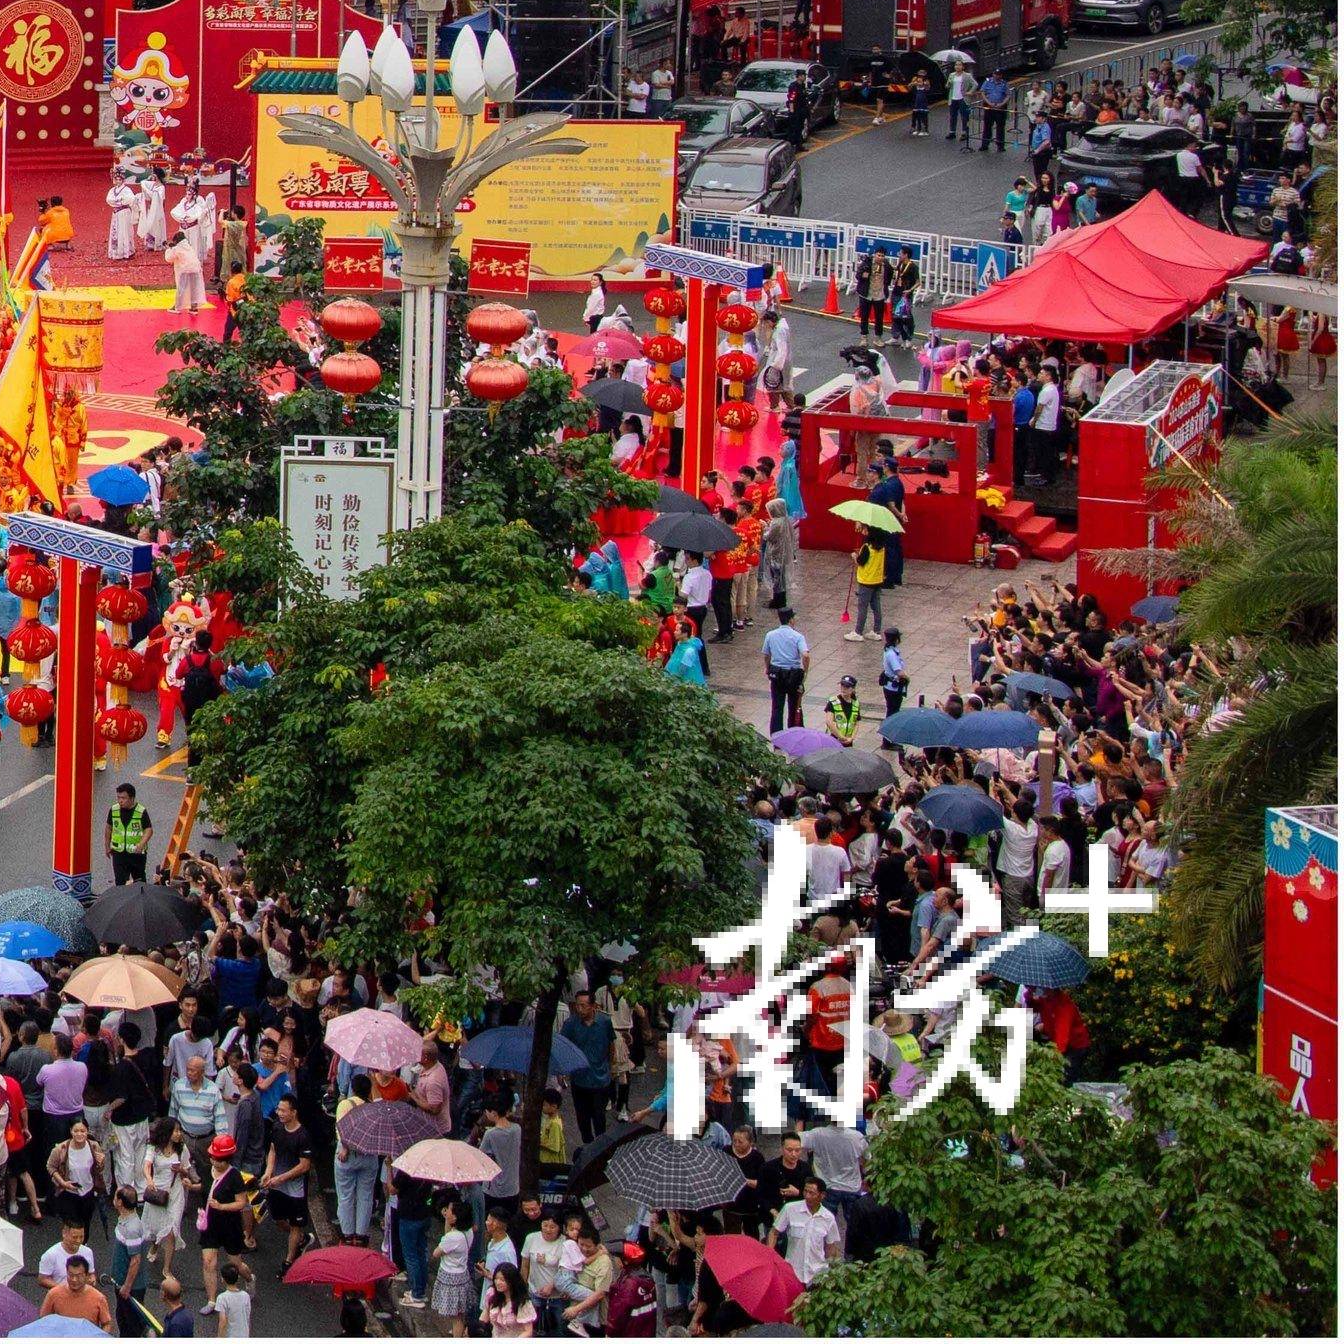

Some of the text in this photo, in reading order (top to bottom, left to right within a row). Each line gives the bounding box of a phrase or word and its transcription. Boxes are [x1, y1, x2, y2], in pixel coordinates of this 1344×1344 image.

[2, 13, 64, 85] 福
[650, 296, 664, 312] 福
[727, 312, 740, 327] 福
[650, 343, 664, 358] 福
[728, 360, 742, 377] 福
[658, 389, 672, 404] 福
[726, 410, 740, 426] 福
[16, 574, 34, 593] 福
[98, 599, 111, 615] 福
[124, 602, 140, 618] 福
[12, 640, 25, 657] 福
[35, 639, 49, 656] 福
[113, 662, 132, 681] 福
[19, 702, 36, 720] 福
[101, 718, 118, 737] 福
[130, 721, 143, 736] 福
